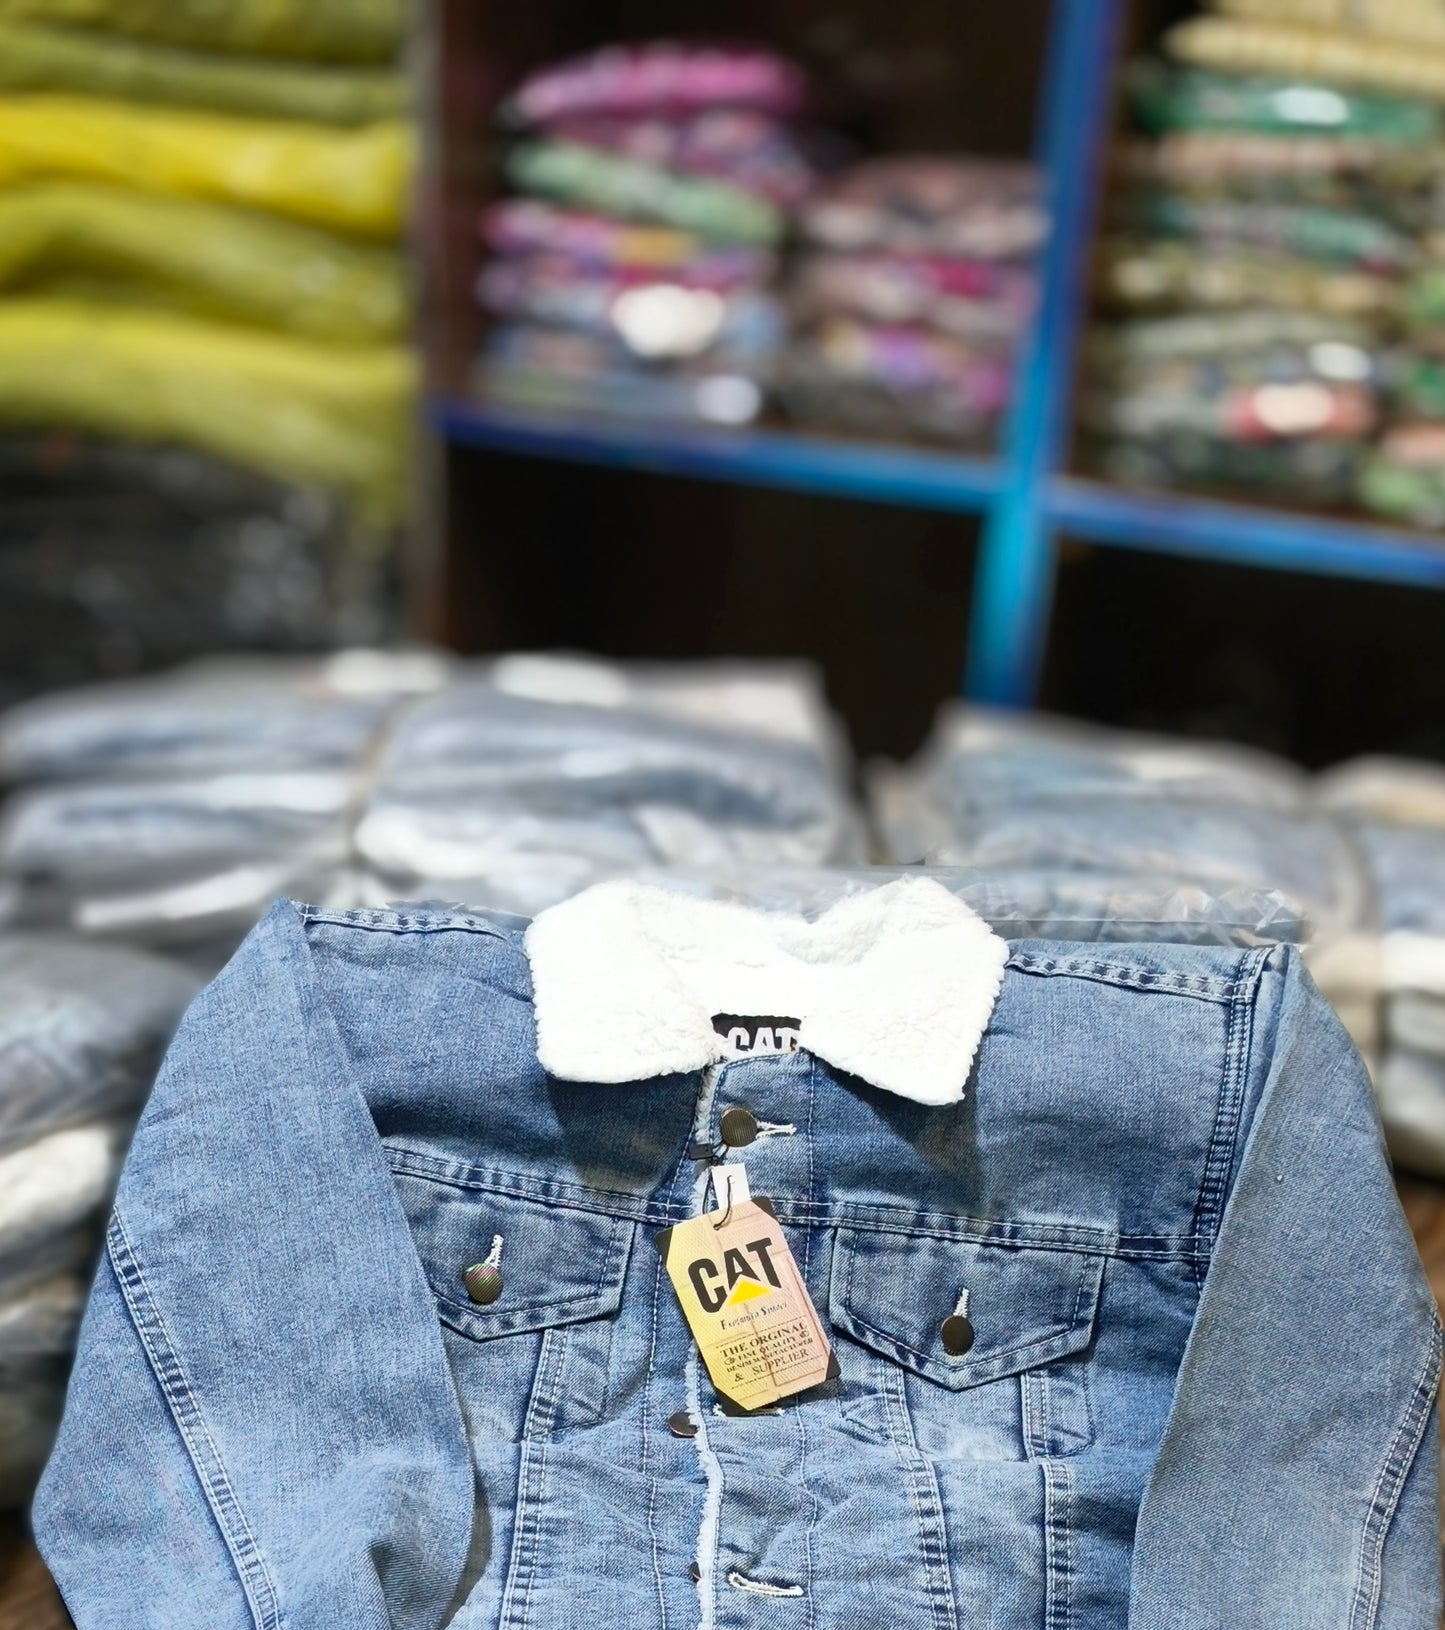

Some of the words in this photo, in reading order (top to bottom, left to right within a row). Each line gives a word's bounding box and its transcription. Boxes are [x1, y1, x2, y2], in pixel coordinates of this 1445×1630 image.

[728, 1027, 799, 1053] CAT
[688, 1237, 781, 1313] CAT
[720, 1343, 748, 1357] THE
[760, 1336, 796, 1354] QUALITY
[734, 1373, 744, 1382] &
[752, 1349, 809, 1375] SUPPLIER
